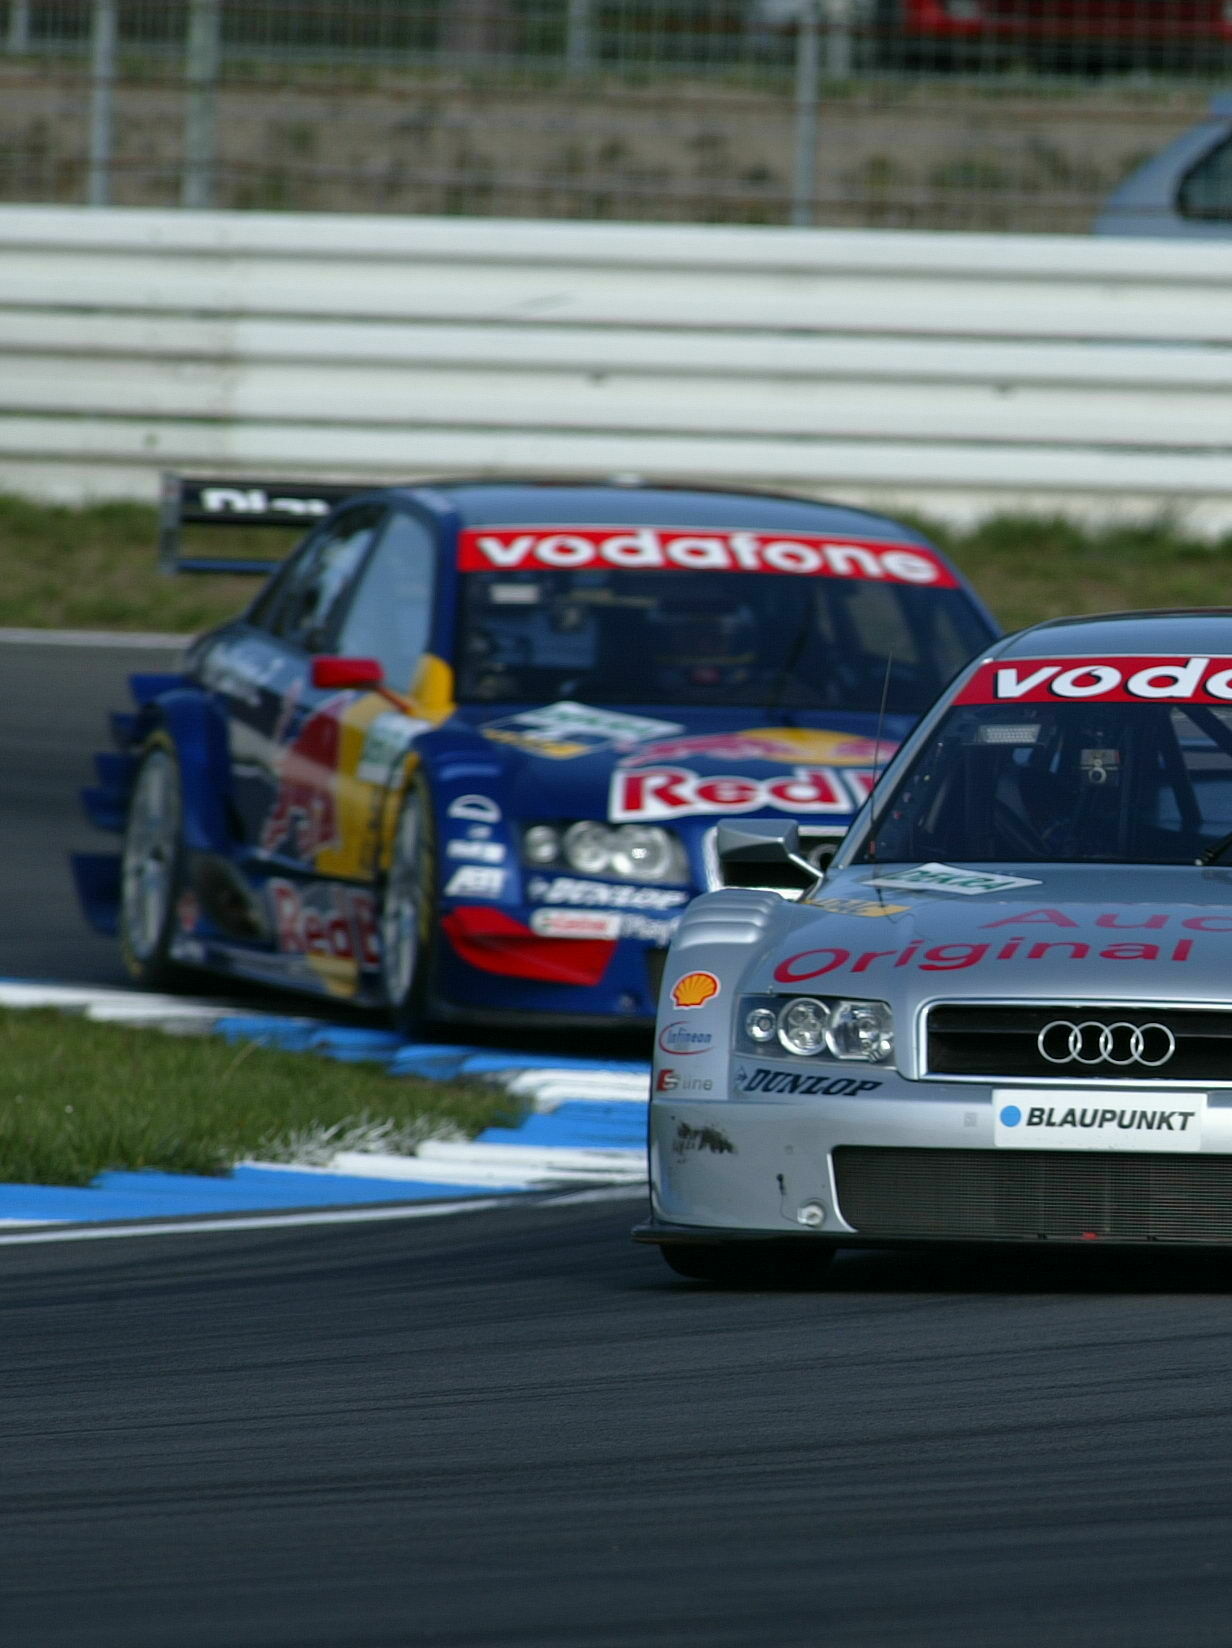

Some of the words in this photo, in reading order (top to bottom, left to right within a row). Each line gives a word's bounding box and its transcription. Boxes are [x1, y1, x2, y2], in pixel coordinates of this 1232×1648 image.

[477, 530, 939, 584] vodafone
[621, 768, 842, 812] Red
[772, 937, 1195, 984] Original
[666, 1026, 713, 1045] Infineon
[742, 1068, 884, 1098] DUNLOP
[1025, 1106, 1195, 1132] BLAUPUNKT
